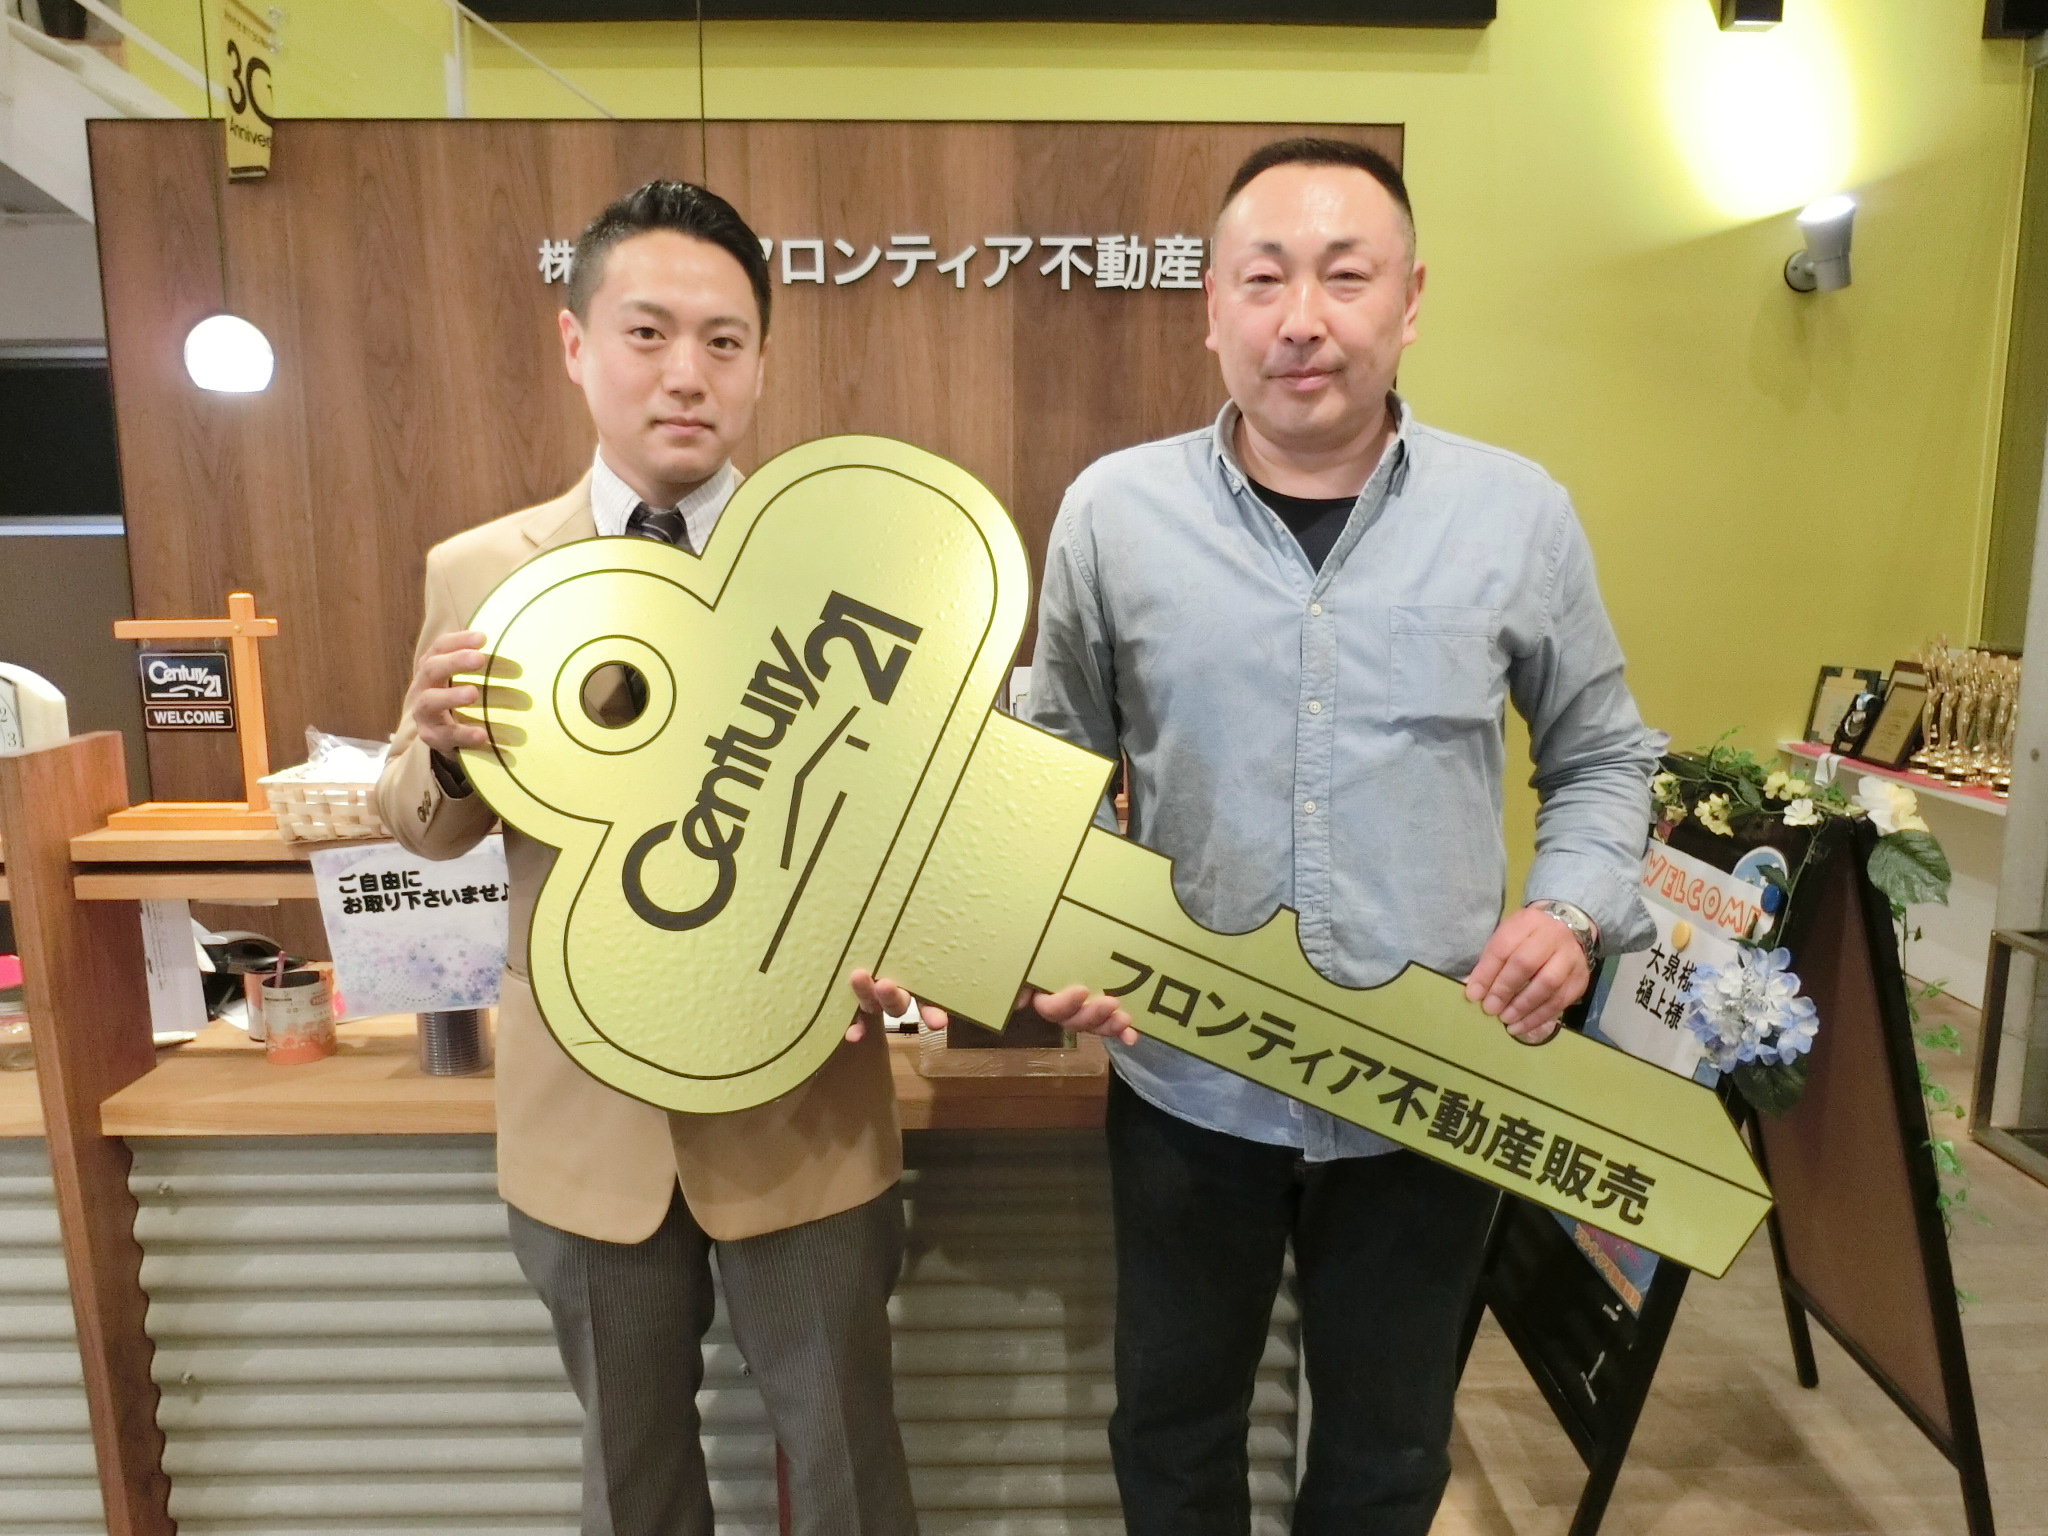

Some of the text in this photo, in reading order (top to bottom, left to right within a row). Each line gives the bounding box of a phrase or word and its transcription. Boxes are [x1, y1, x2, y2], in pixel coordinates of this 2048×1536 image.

[148, 660, 223, 698] Century 21
[153, 710, 225, 724] WELCOME
[621, 589, 924, 932] Century 21
[338, 870, 423, 894] ご自由に
[1103, 950, 1656, 1227] フロンティア不動産販売
